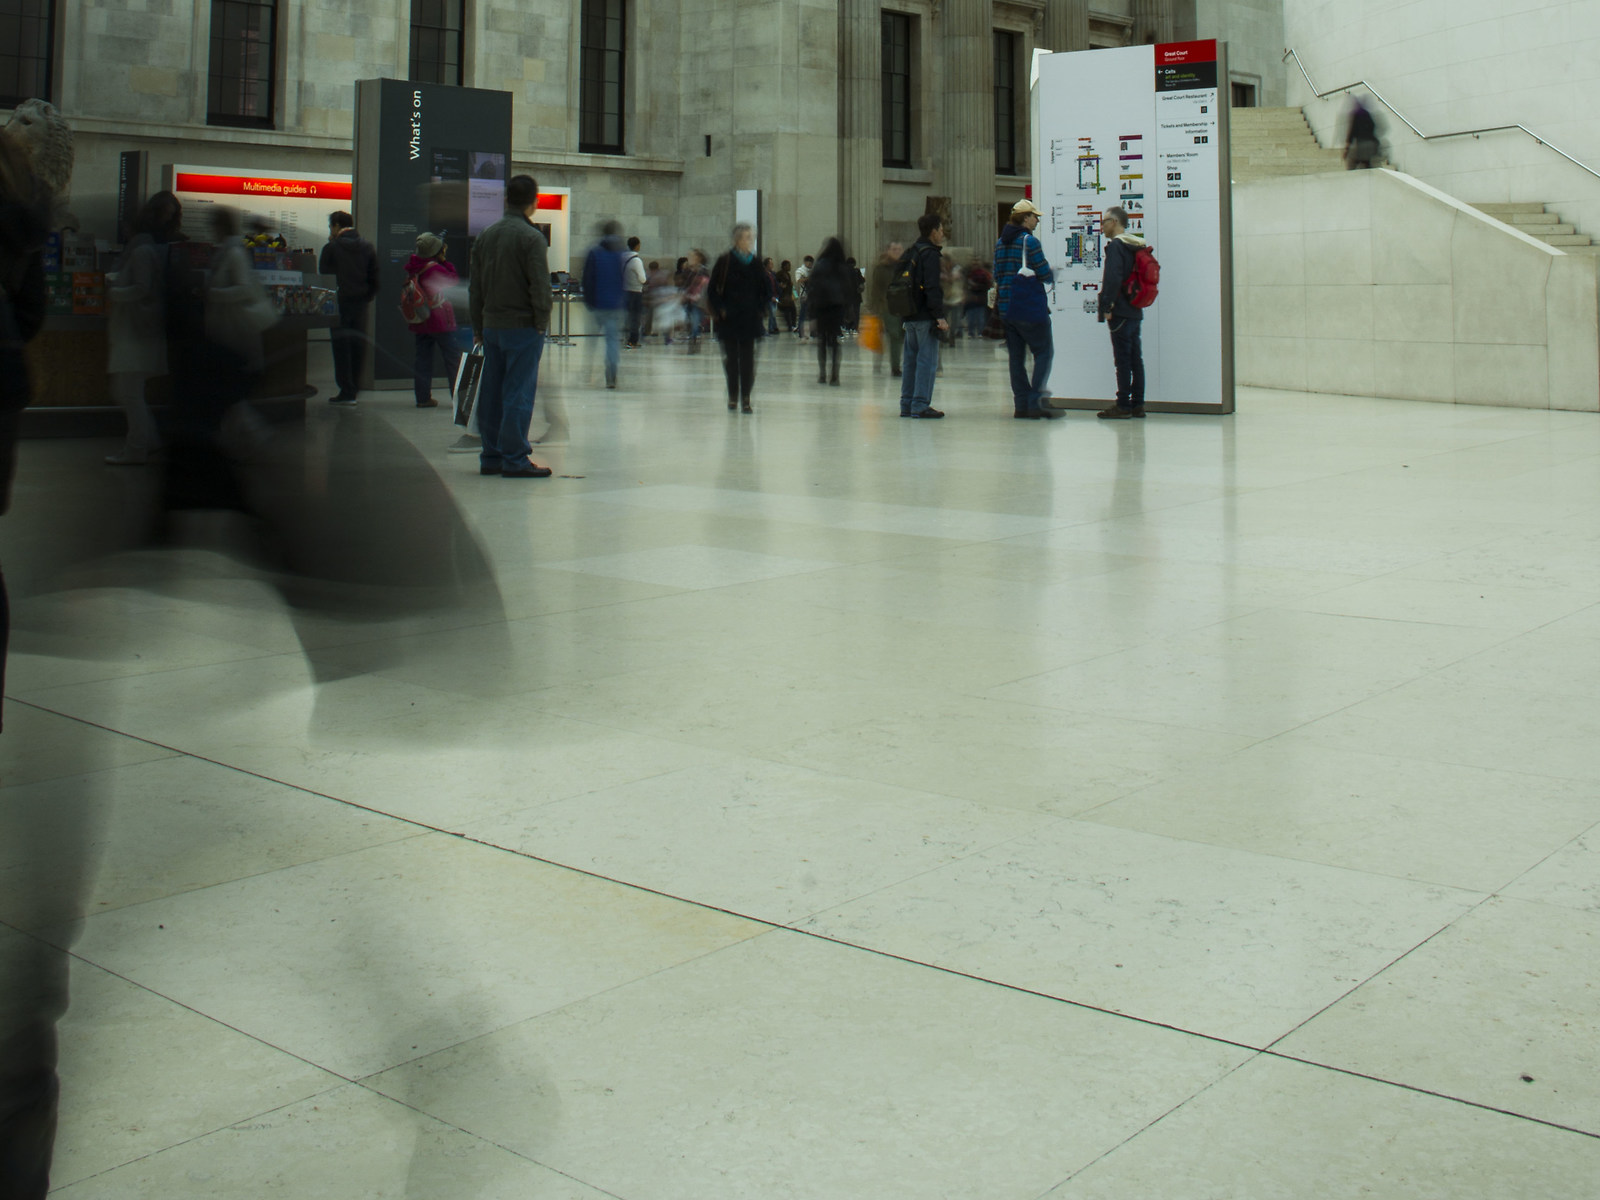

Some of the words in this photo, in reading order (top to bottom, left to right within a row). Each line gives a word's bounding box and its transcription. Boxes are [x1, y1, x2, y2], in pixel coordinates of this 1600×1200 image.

[413, 89, 422, 108] on
[409, 110, 421, 160] What's
[243, 181, 282, 194] Multimedia
[282, 184, 308, 195] guides
